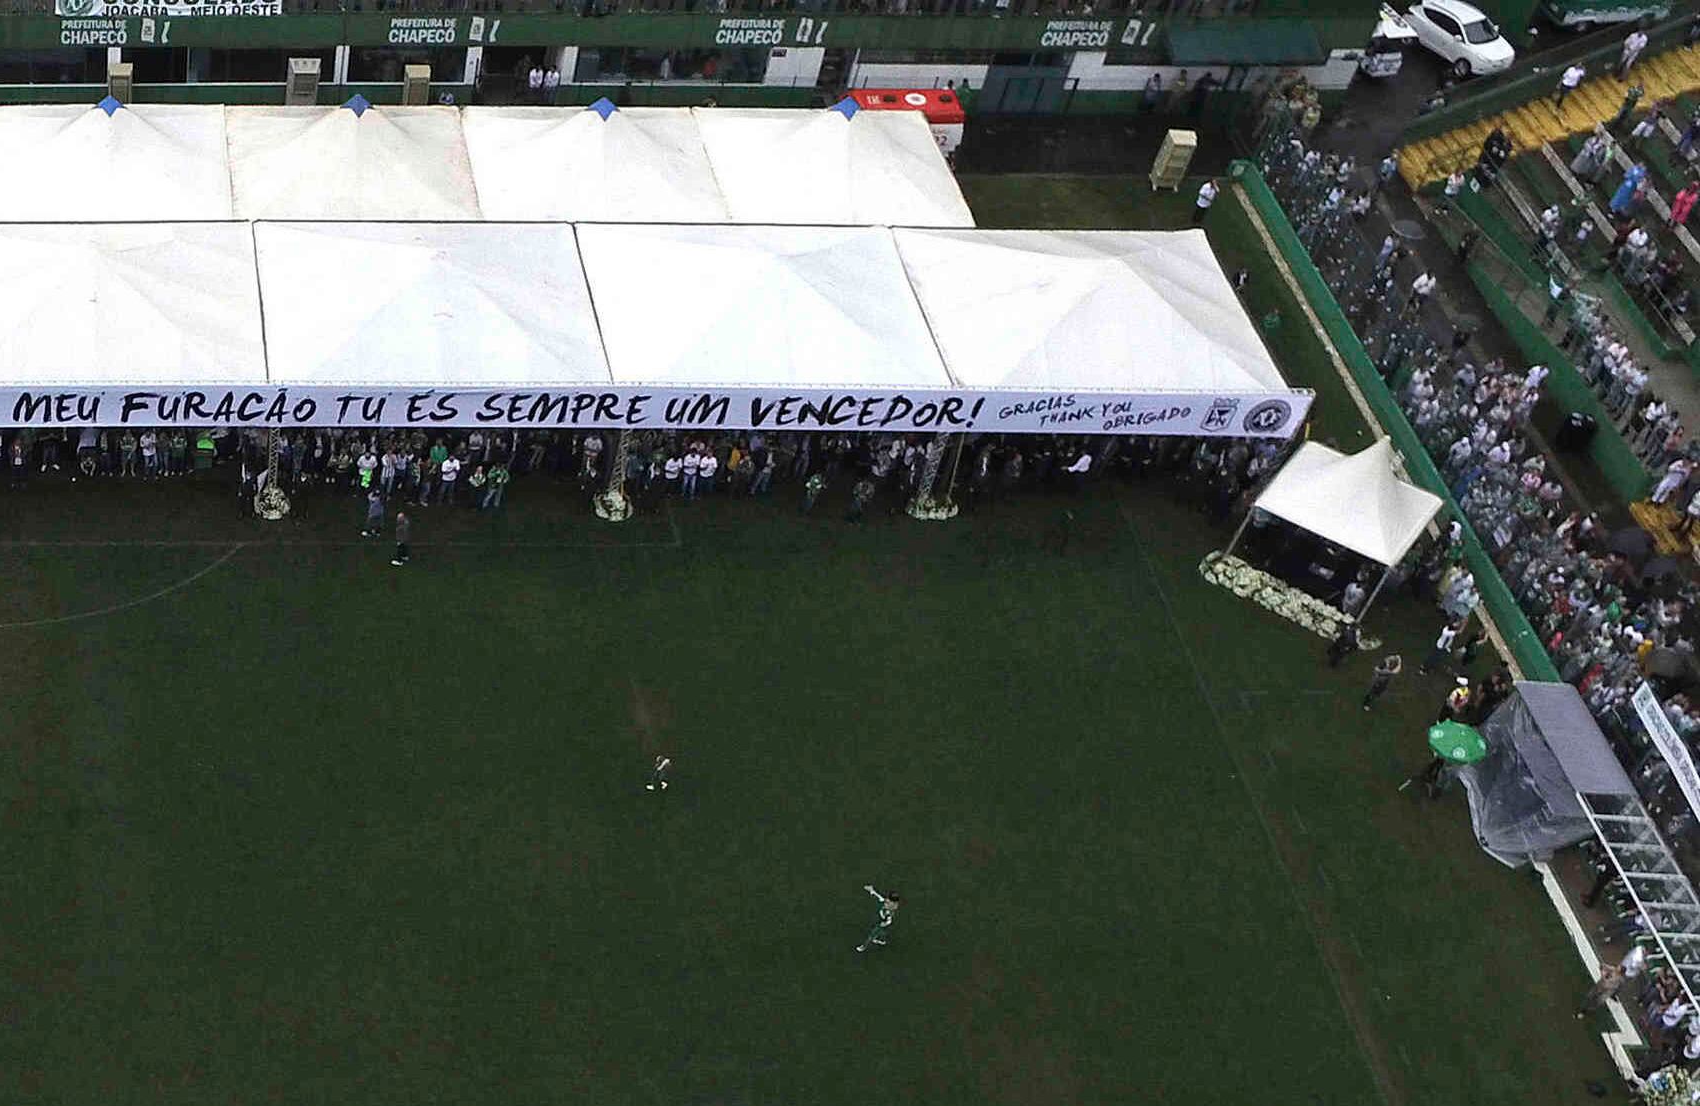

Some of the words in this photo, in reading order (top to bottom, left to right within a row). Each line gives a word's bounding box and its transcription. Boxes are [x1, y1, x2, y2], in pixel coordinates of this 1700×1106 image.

[61, 20, 112, 29] PREFEITURA
[113, 20, 127, 30] DE
[390, 18, 442, 28] PREFEITURA
[444, 18, 458, 29] DE
[719, 19, 771, 30] PREFEITURA
[772, 19, 786, 29] DE
[1100, 21, 1113, 30] DE
[60, 29, 127, 44] CHAPECÓ
[388, 29, 455, 43] CHAPECÓ
[715, 29, 783, 44] CHAPECÓ
[1041, 31, 1108, 46] CHAPECÓ
[12, 391, 104, 424] MEU
[336, 394, 387, 424] TU
[406, 389, 460, 423] ÉS
[475, 392, 653, 425] SEMPRE
[664, 393, 740, 426] UM
[750, 394, 986, 429] VENCEDOR!
[999, 395, 1077, 419] GRACIAS
[1039, 405, 1096, 428] THANK
[1102, 401, 1132, 418] YOU
[1102, 406, 1192, 431] OBRIGADO
